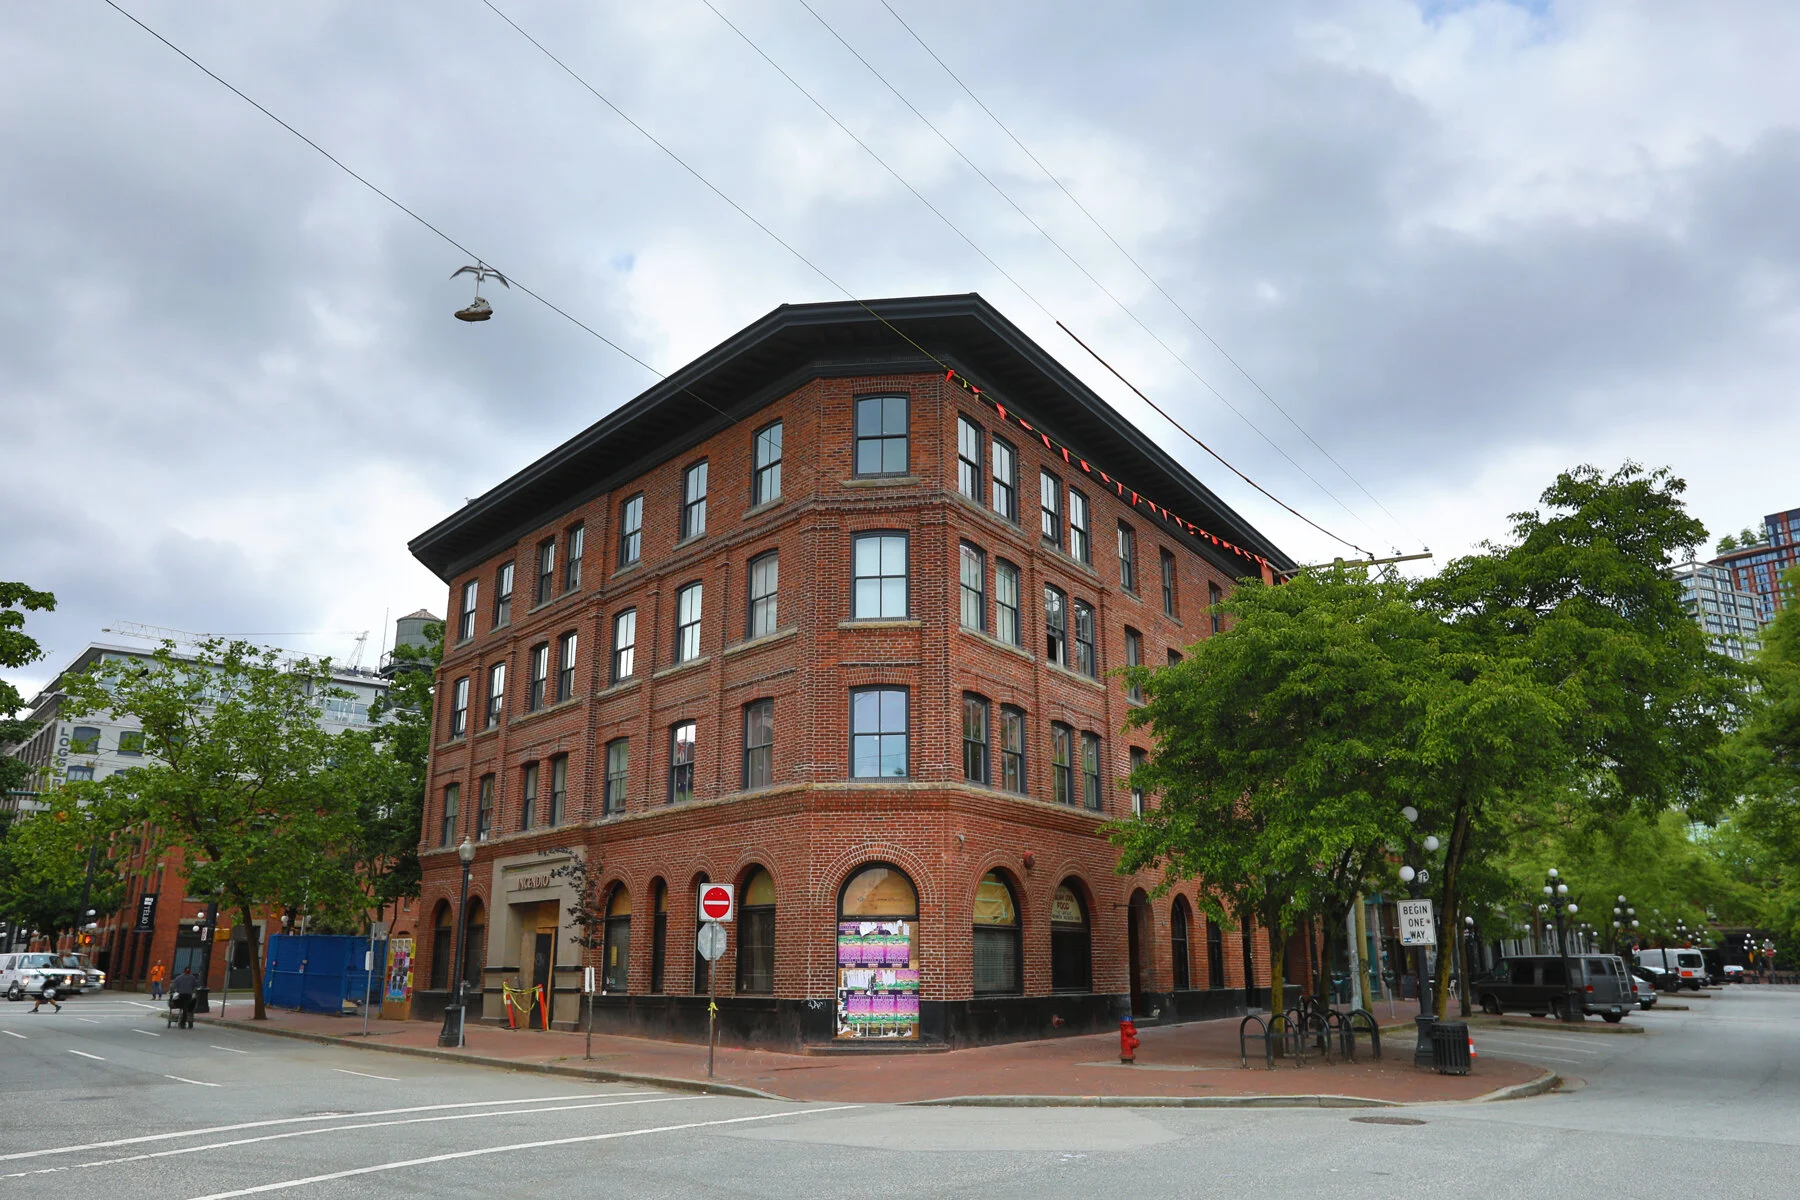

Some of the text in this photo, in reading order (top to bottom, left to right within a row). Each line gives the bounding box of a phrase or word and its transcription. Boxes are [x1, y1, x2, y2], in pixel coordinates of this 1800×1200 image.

[517, 875, 550, 889] INCENDIO
[1403, 906, 1428, 915] BEGIN
[1408, 918, 1425, 927] ONE
[1410, 931, 1425, 939] WAY
